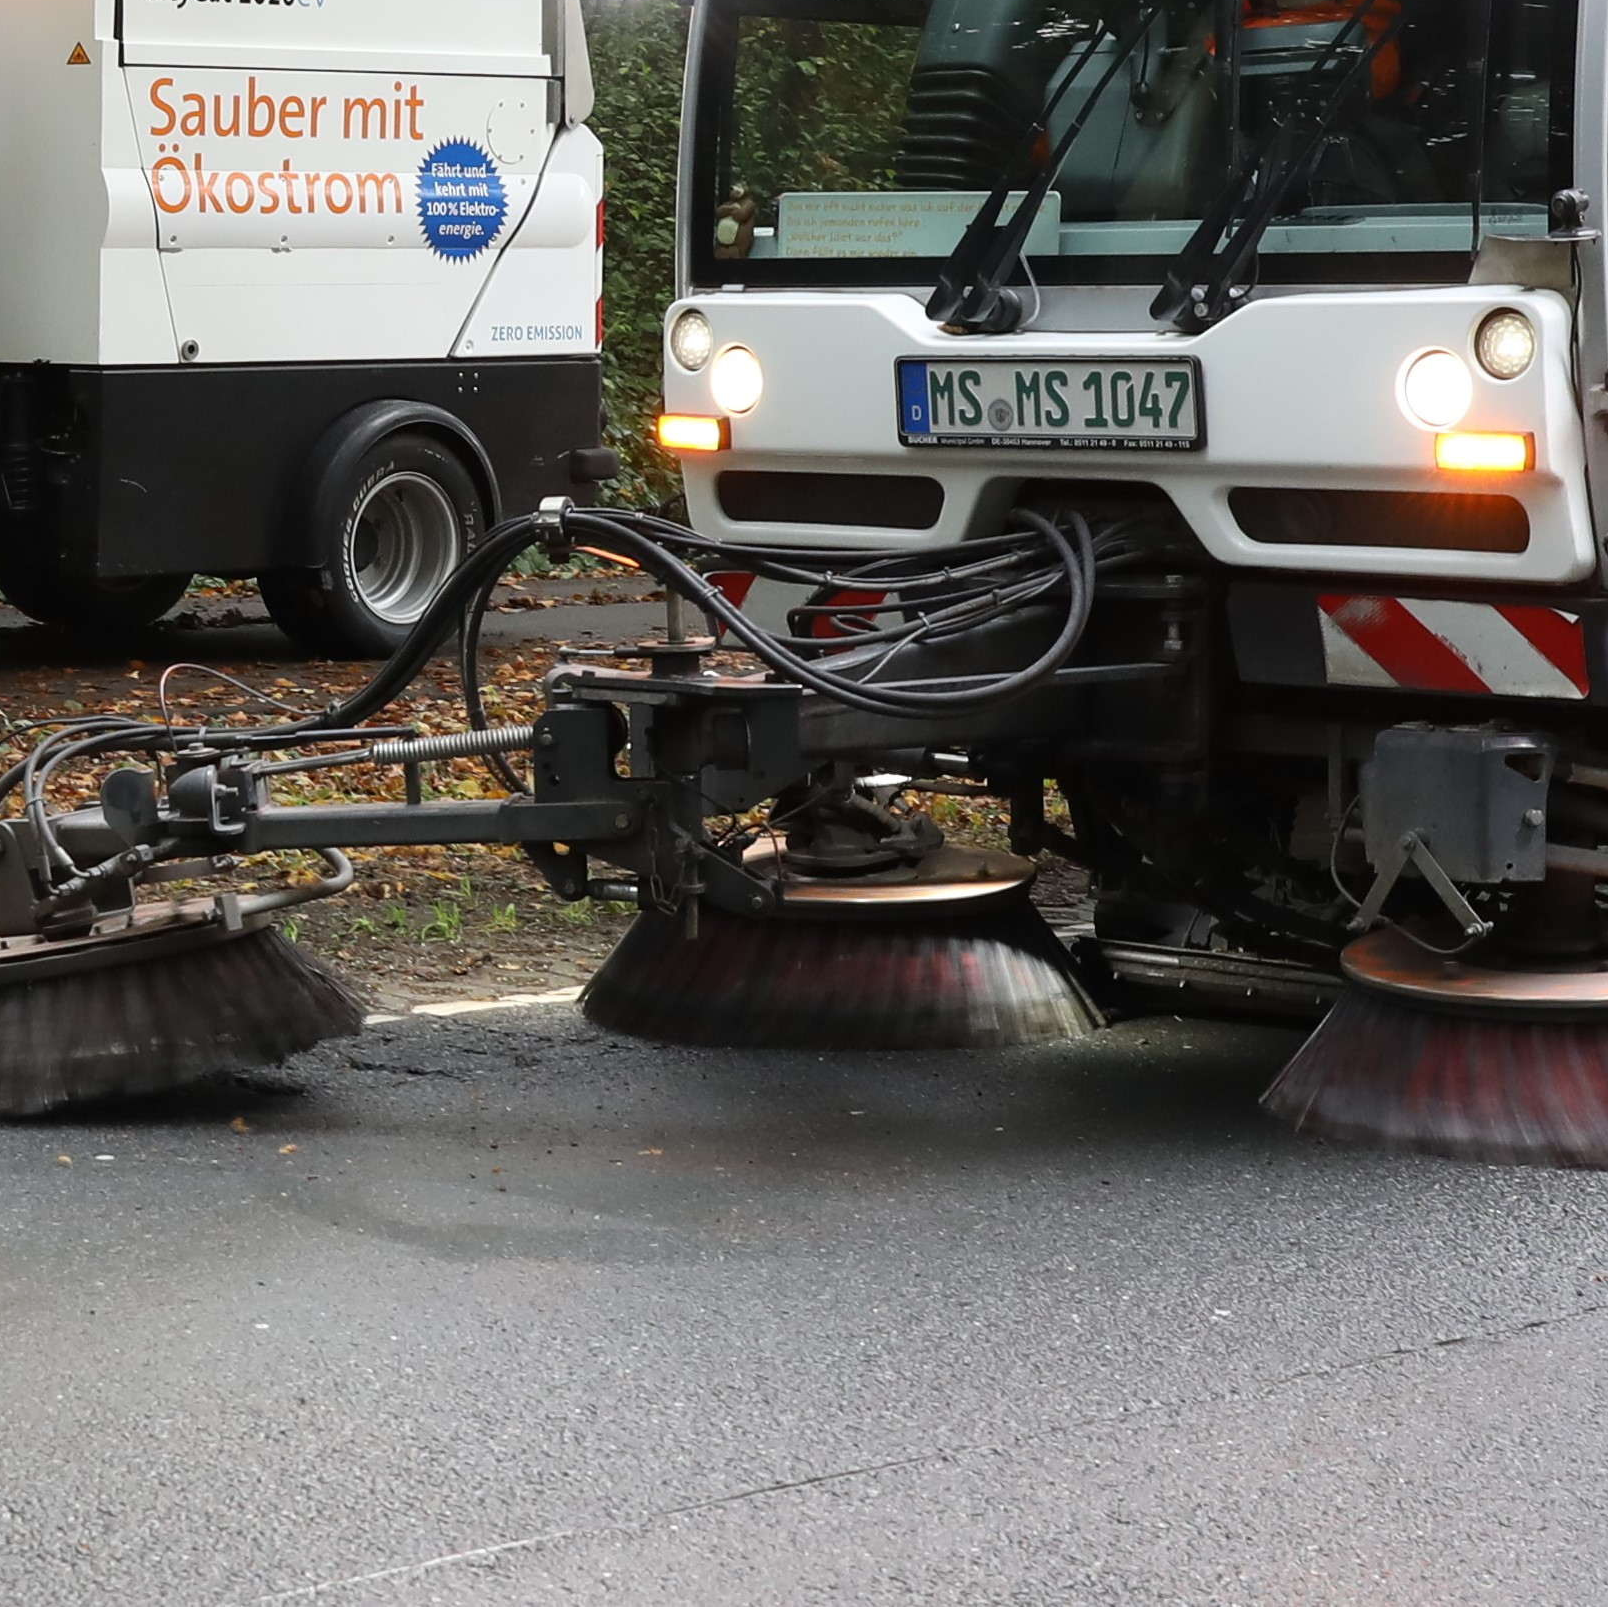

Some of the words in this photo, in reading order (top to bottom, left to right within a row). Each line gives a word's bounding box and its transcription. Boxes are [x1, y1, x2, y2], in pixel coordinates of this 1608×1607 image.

[150, 76, 328, 138] Sauber
[343, 81, 424, 141] mit
[151, 143, 403, 214] Ökostrom
[431, 163, 462, 178] Fährt
[464, 163, 487, 178] und
[434, 182, 467, 197] kehrt
[469, 182, 489, 197] mit
[460, 201, 500, 216] Elektro-
[439, 221, 485, 240] energie.
[491, 325, 524, 341] ZERO
[526, 325, 582, 341] EMISSION
[929, 370, 983, 427] MS
[1015, 370, 1070, 427] MS
[1083, 371, 1191, 428] 1047
[907, 436, 938, 444] BUCHER
